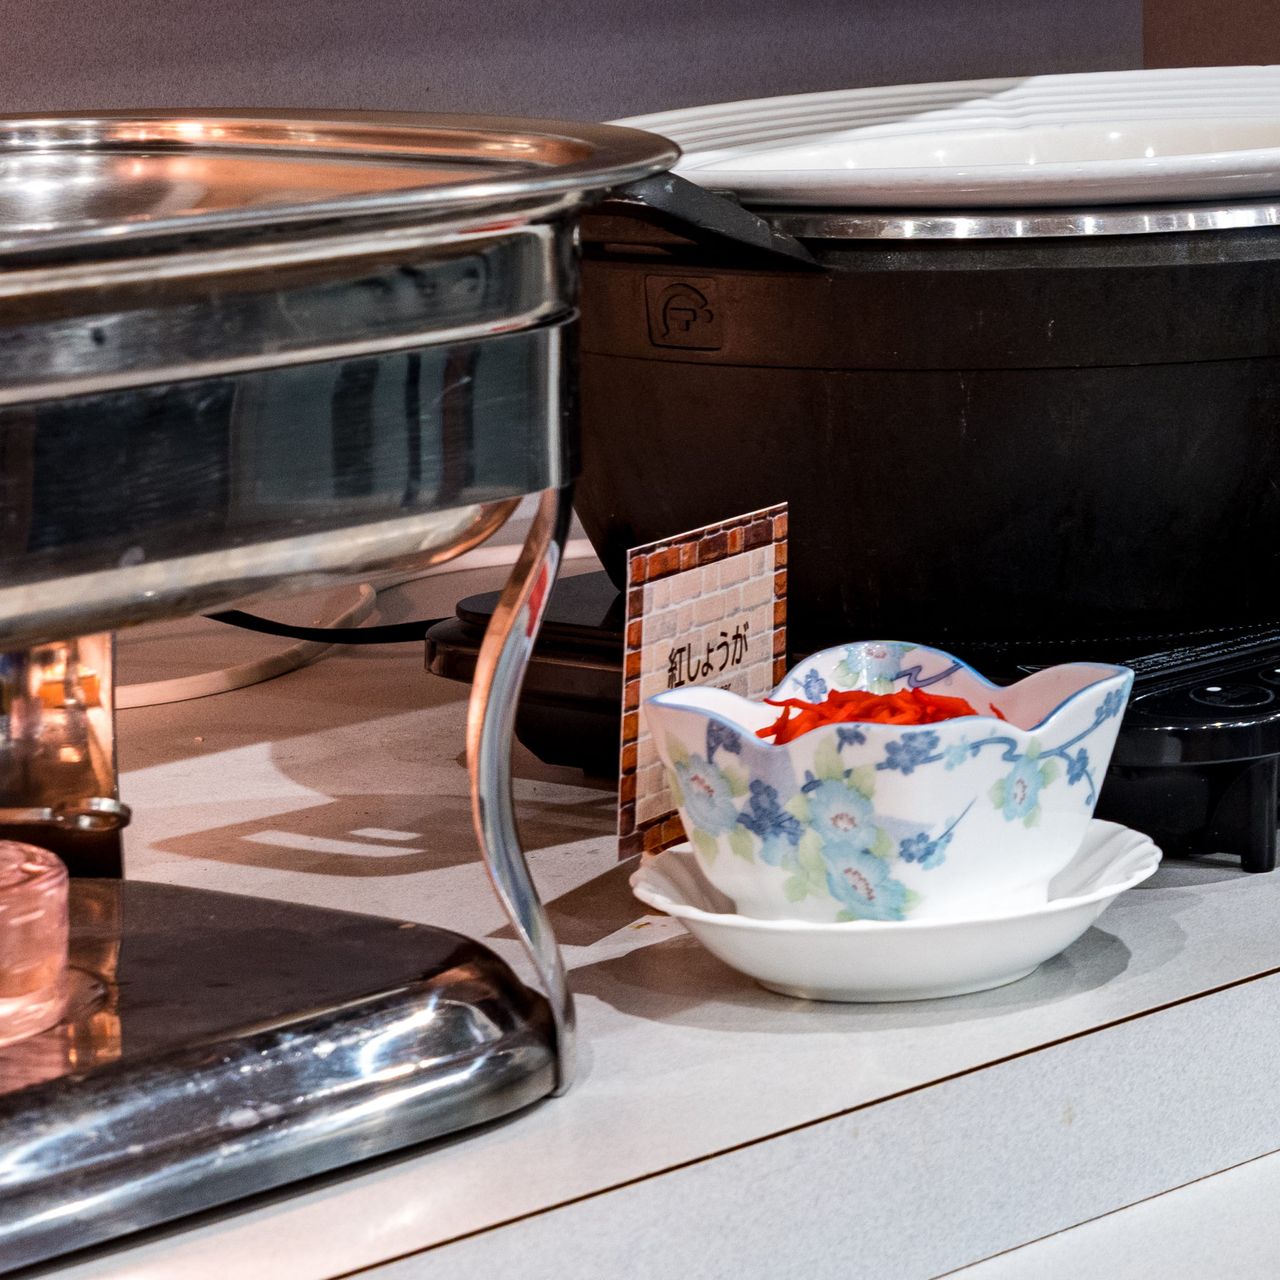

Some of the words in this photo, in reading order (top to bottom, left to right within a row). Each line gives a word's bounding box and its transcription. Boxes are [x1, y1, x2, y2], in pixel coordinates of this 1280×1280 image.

[667, 621, 750, 689] 紅しょうが
